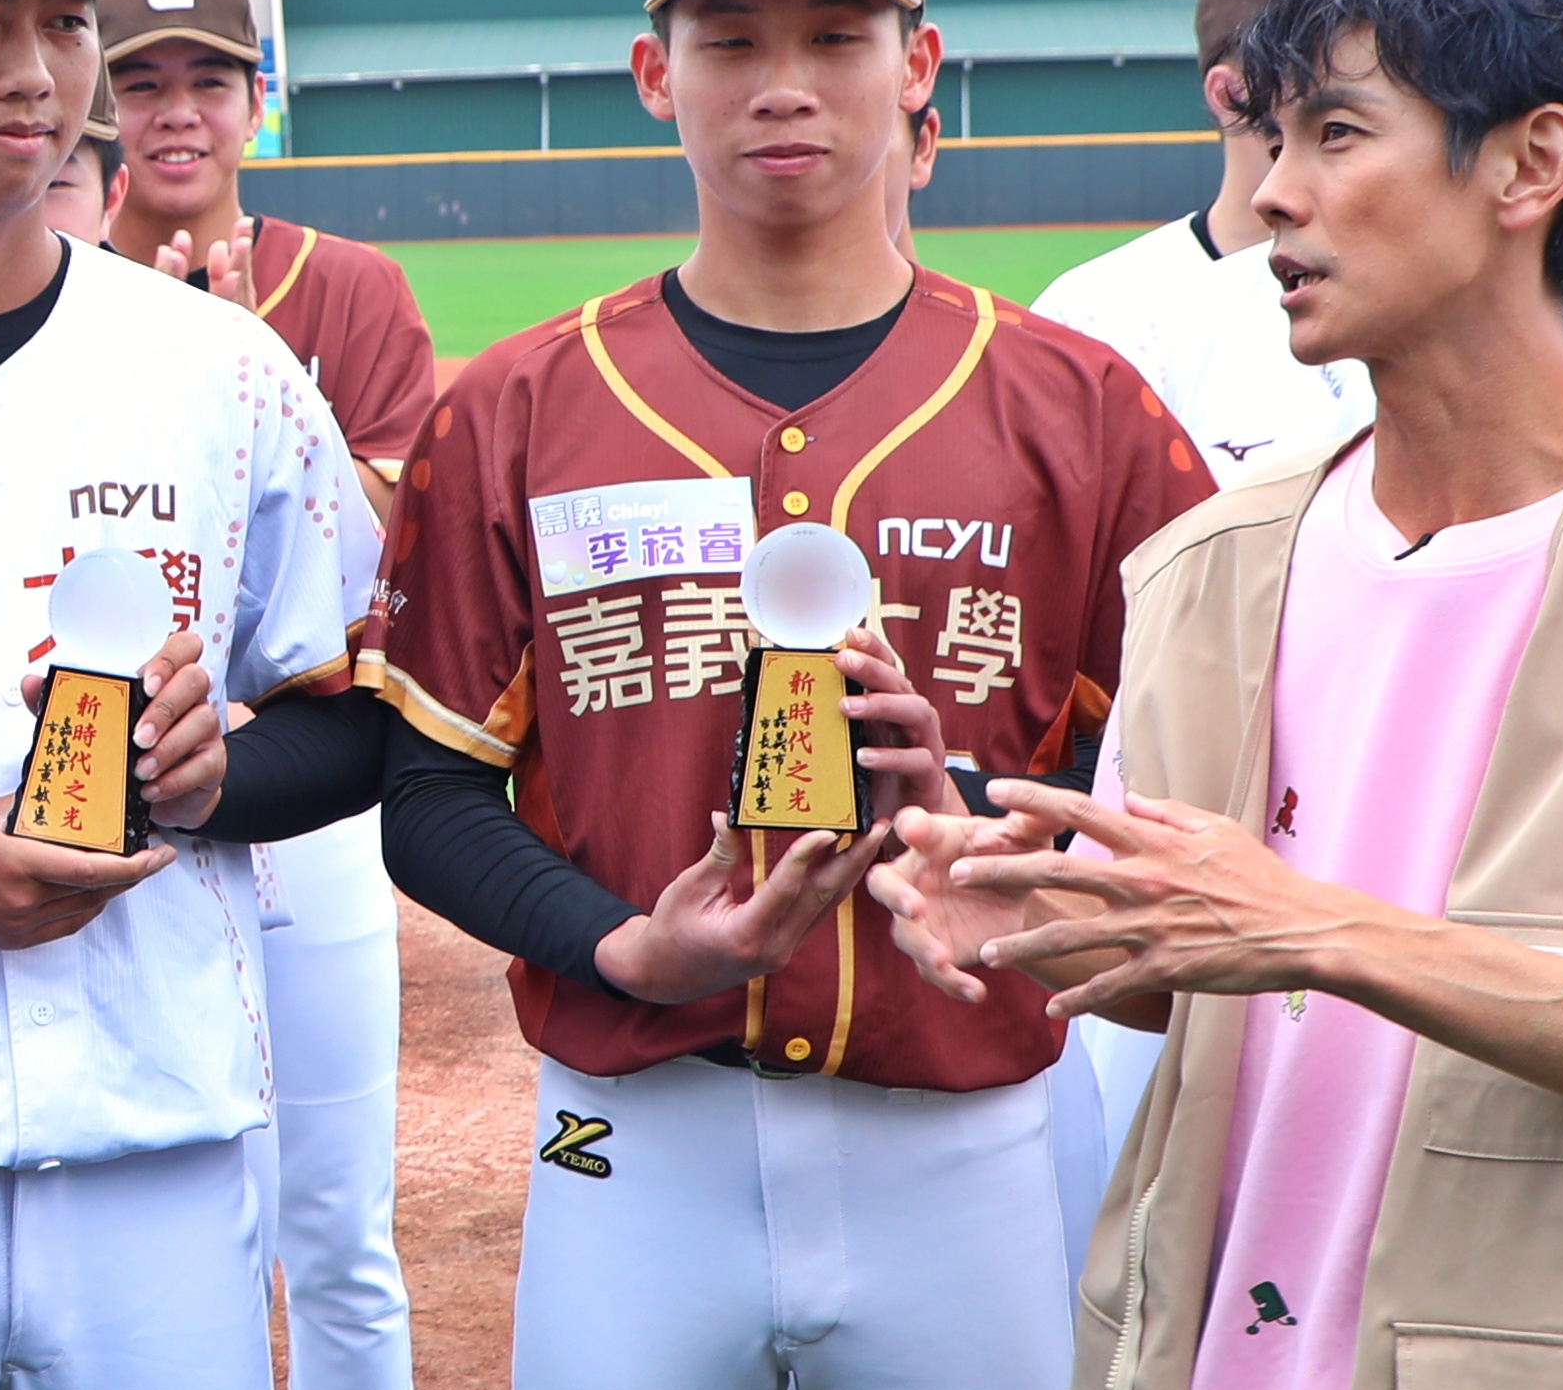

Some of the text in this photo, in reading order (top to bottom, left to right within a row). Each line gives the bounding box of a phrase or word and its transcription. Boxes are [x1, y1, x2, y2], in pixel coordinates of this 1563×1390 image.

[536, 495, 670, 538] 嘉義 Chiayi
[588, 522, 742, 575] 李崧睿
[61, 692, 102, 832] 新時代之光
[785, 670, 816, 813] 新時代之光
[558, 1149, 607, 1174] YEMO
